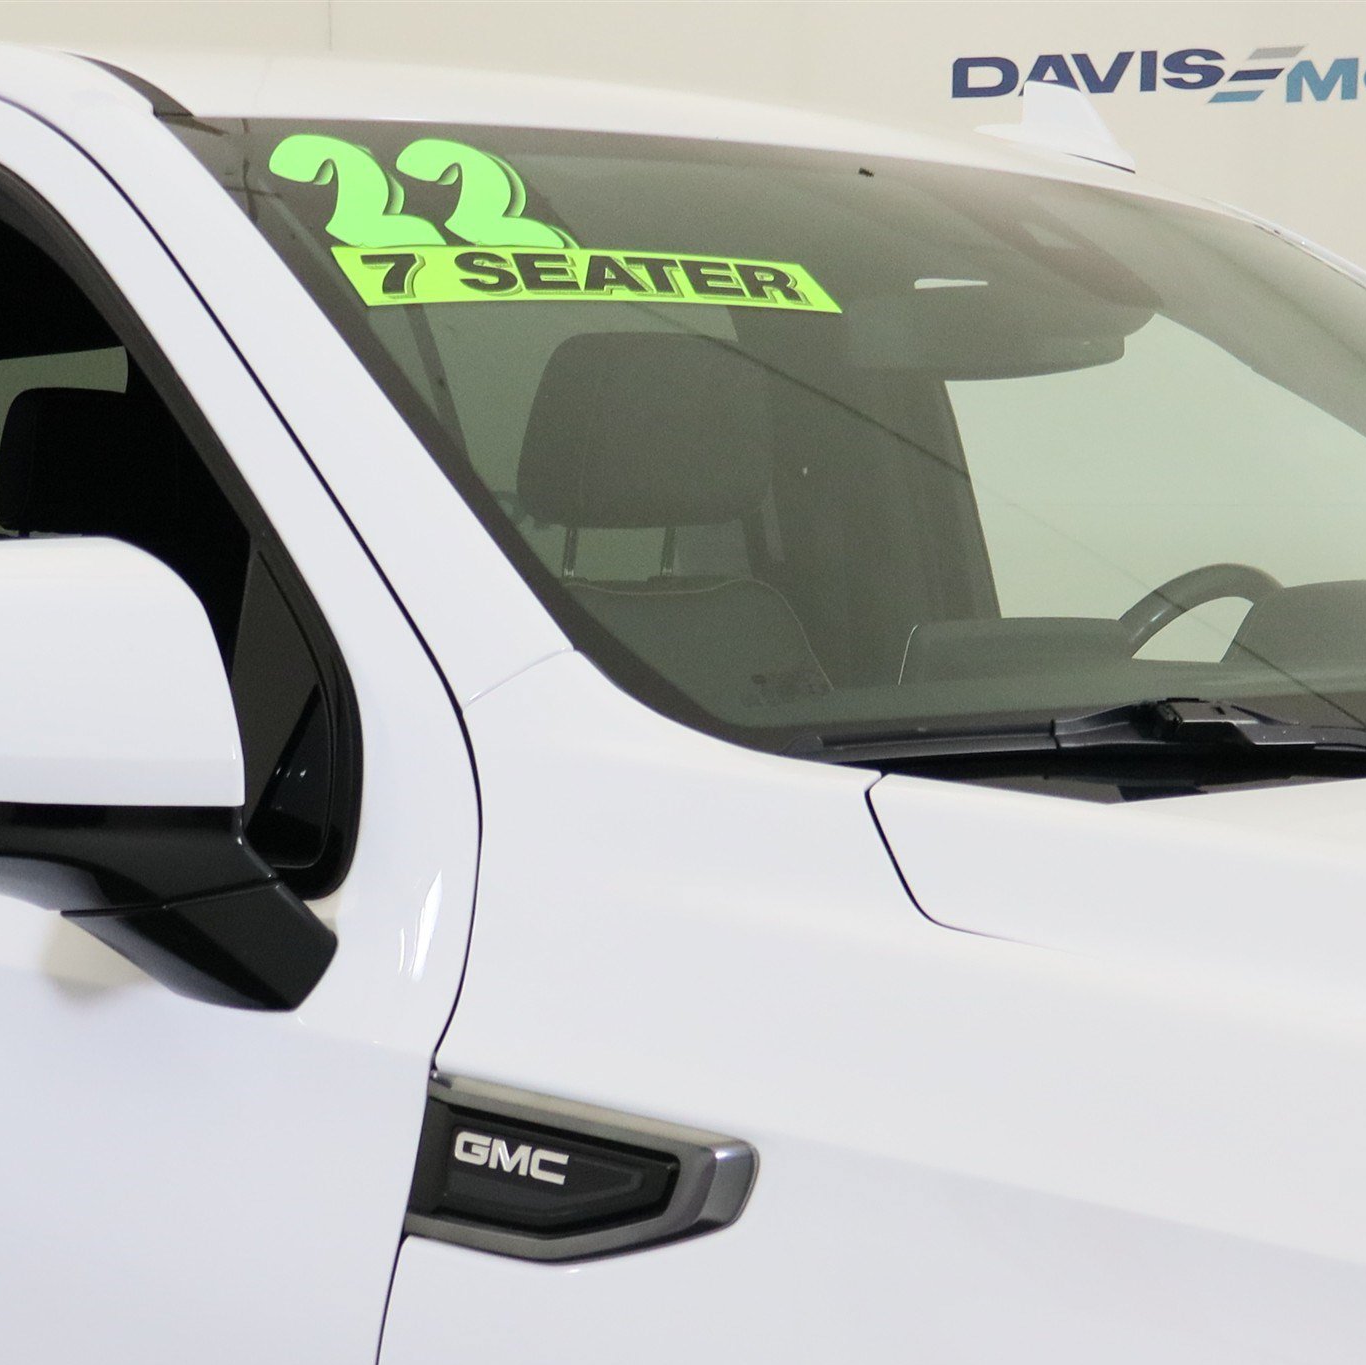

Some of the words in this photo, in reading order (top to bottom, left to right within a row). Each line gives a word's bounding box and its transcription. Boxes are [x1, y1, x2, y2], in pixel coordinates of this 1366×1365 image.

[951, 48, 1225, 98] DAVIS
[267, 133, 575, 249] 22
[360, 252, 425, 299] 7
[454, 250, 812, 306] SEATER
[453, 1130, 571, 1186] GMC
